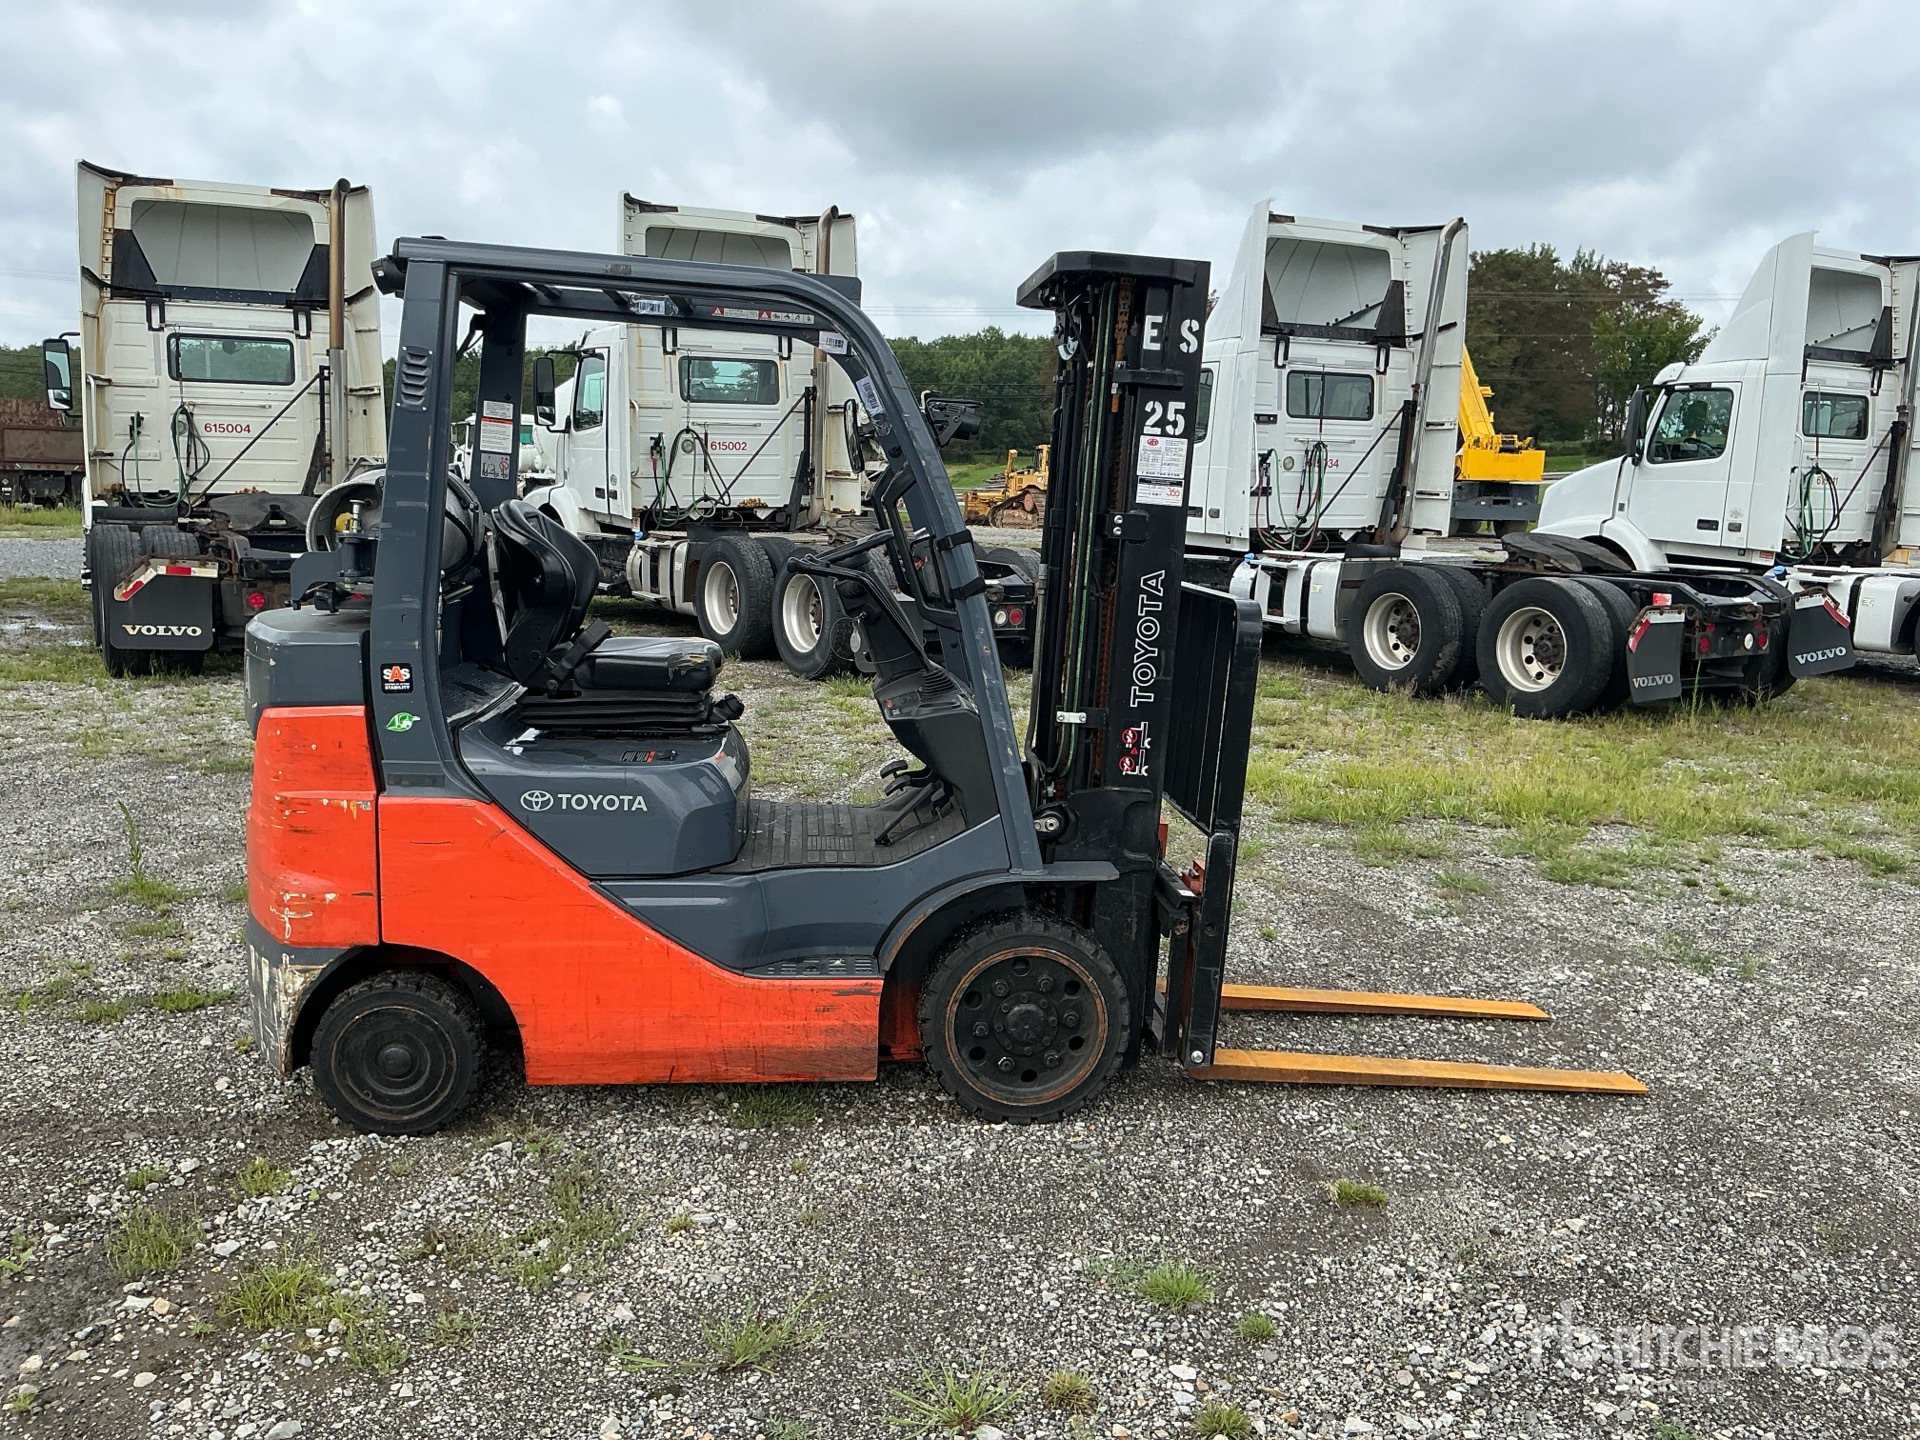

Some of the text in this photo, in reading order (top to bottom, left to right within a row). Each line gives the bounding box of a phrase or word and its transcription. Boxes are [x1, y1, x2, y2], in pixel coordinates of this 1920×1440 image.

[1143, 315, 1200, 354] E S
[1143, 400, 1186, 435] 25
[204, 422, 252, 433] 615004
[710, 441, 747, 451] 615002
[122, 624, 203, 637] VOLVO
[1130, 569, 1166, 708] TOYOTA
[1795, 646, 1847, 665] VOLVO
[383, 666, 410, 681] SAS
[1632, 673, 1674, 688] VOLVO
[557, 793, 647, 812] TOYOTA
